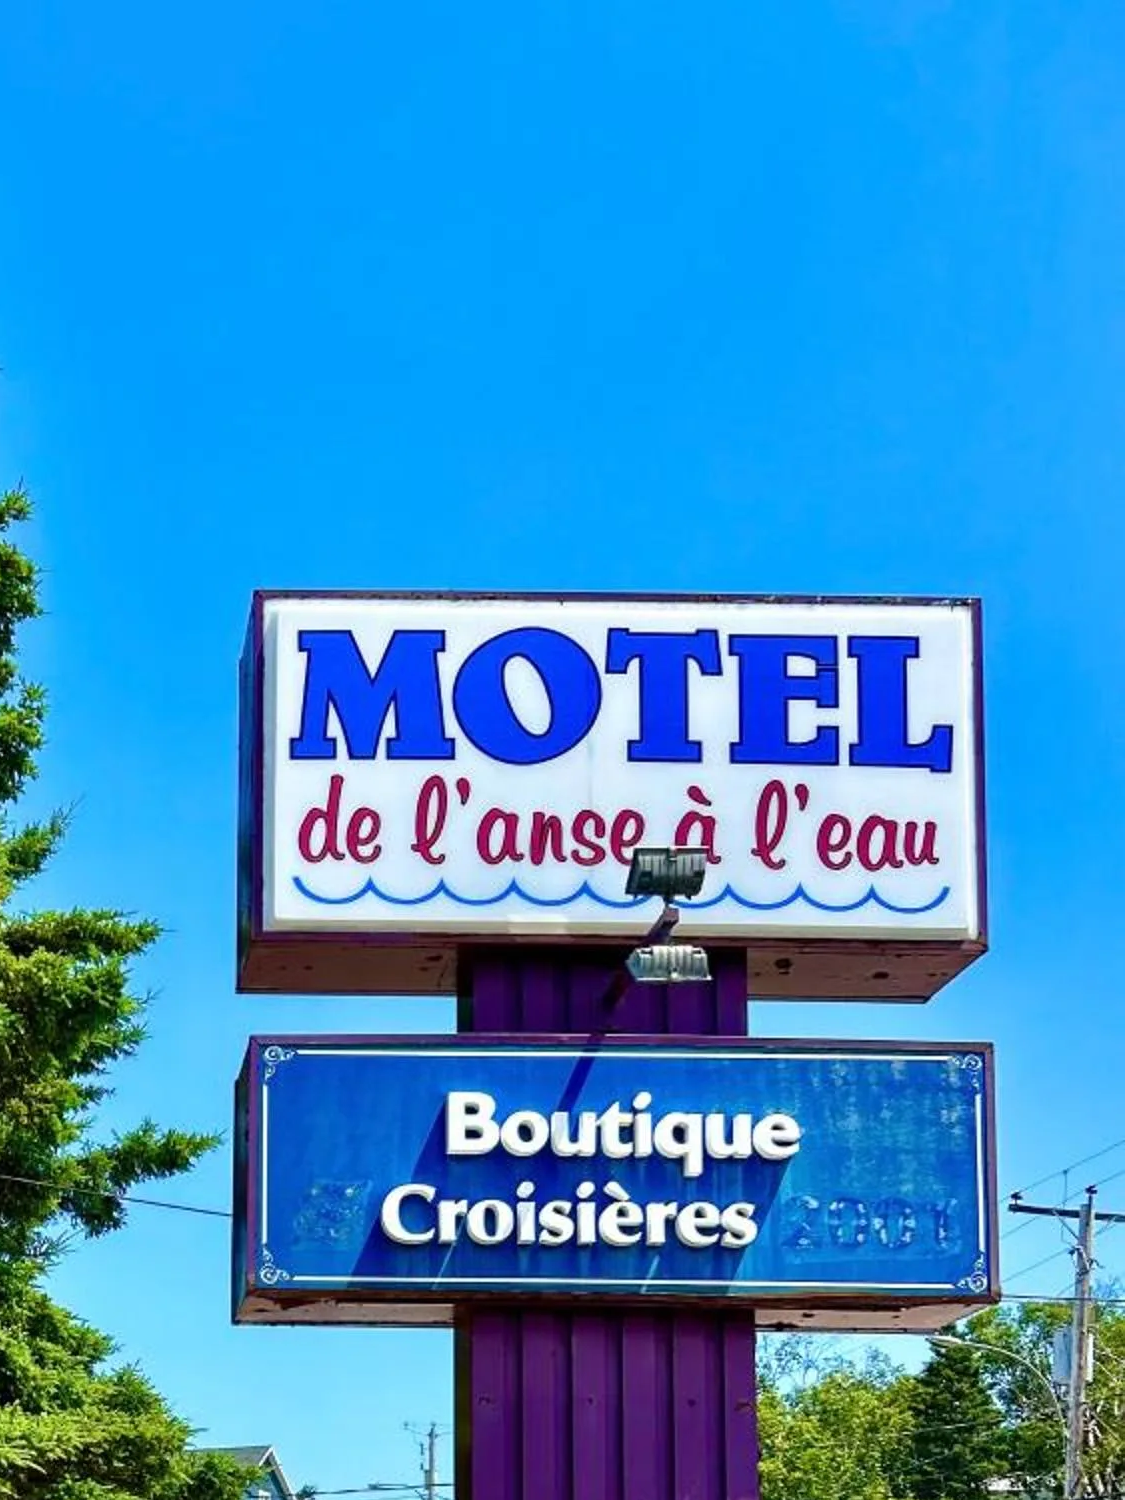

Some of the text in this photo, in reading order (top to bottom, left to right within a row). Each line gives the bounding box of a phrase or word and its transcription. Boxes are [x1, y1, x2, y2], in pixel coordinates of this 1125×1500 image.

[289, 627, 954, 773] MOTEL
[298, 774, 939, 871] de l'anse à l'eau
[446, 1091, 801, 1178] Boutique
[381, 1181, 759, 1248] Croisières
